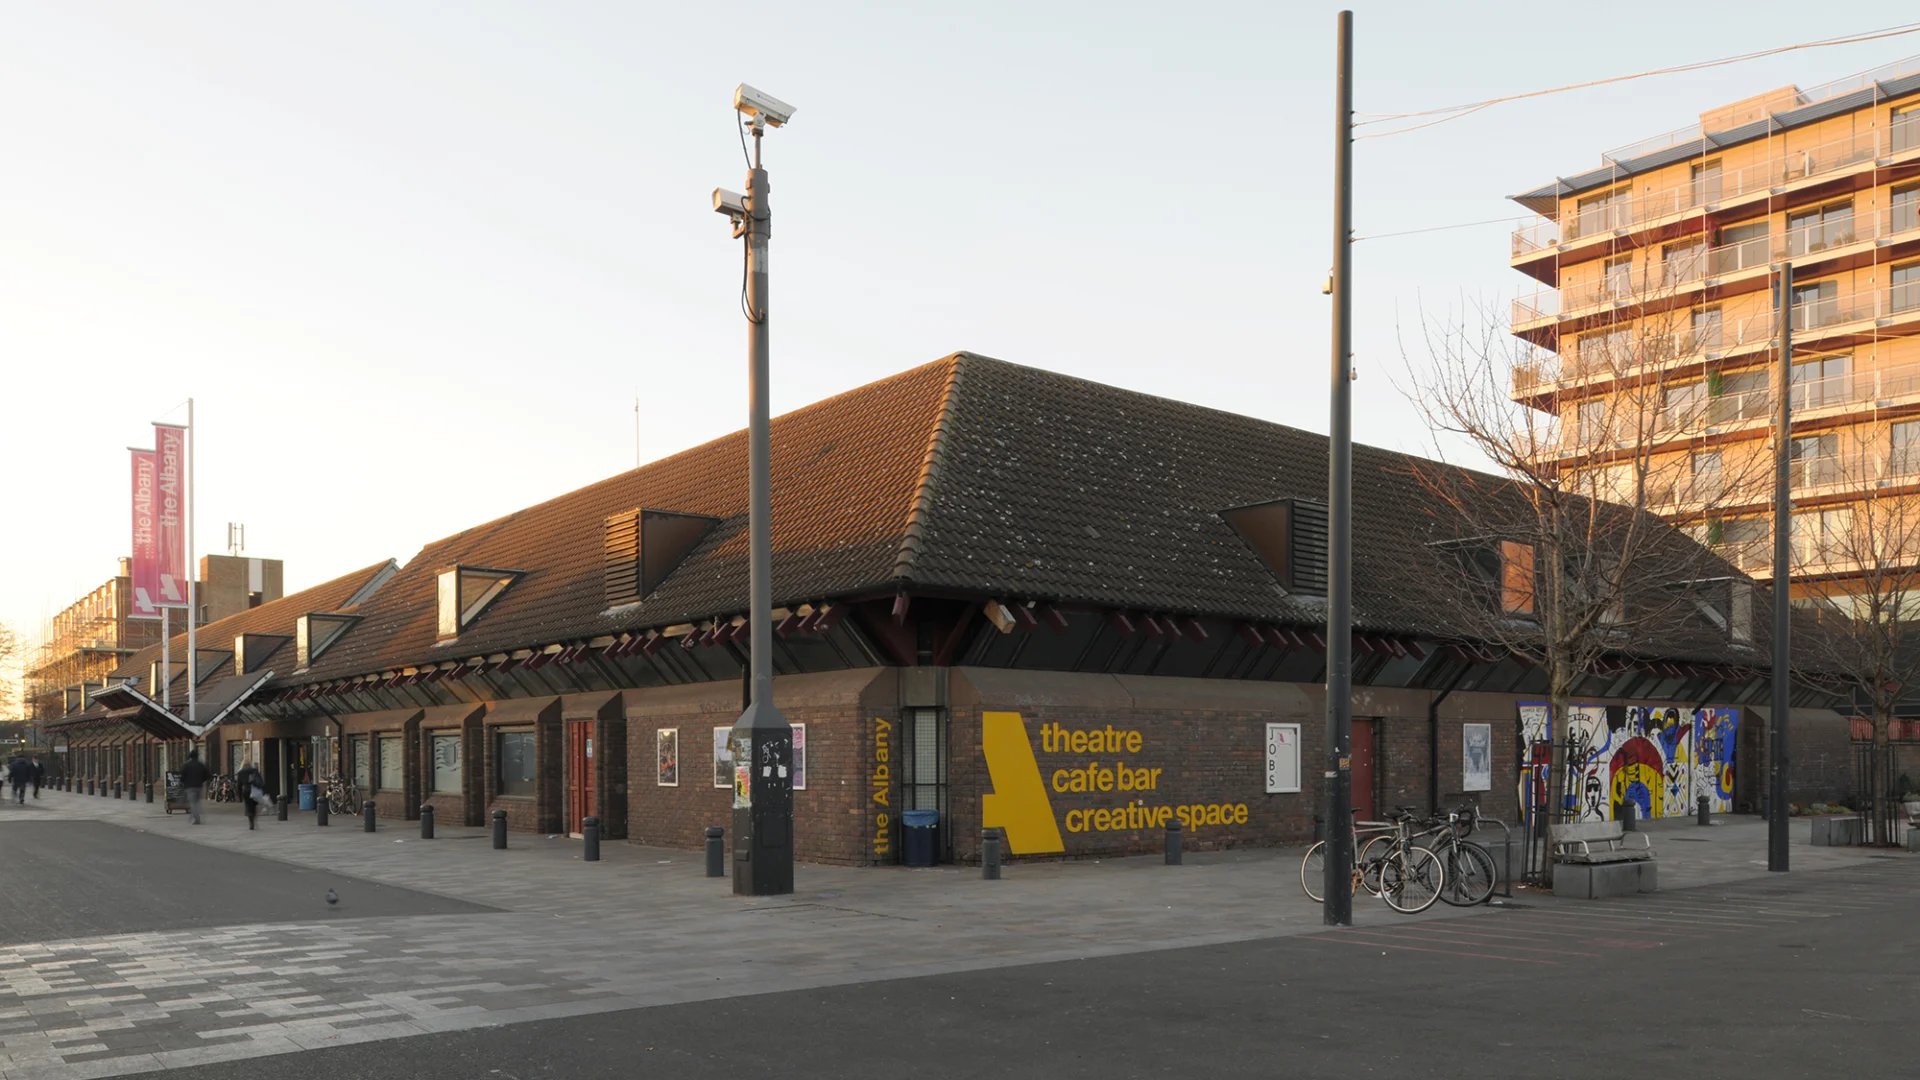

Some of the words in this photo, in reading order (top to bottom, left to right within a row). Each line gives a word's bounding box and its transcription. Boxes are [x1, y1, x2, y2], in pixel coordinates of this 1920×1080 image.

[160, 432, 181, 497] Albany
[135, 457, 154, 515] Albany
[160, 497, 178, 528] the
[136, 517, 152, 544] the
[1039, 722, 1143, 754] theatre
[872, 717, 892, 807] Albany
[1051, 761, 1115, 793] cafe
[1116, 761, 1162, 791] bar
[1065, 800, 1174, 833] creative
[1175, 802, 1249, 833] space
[873, 812, 889, 855] the
